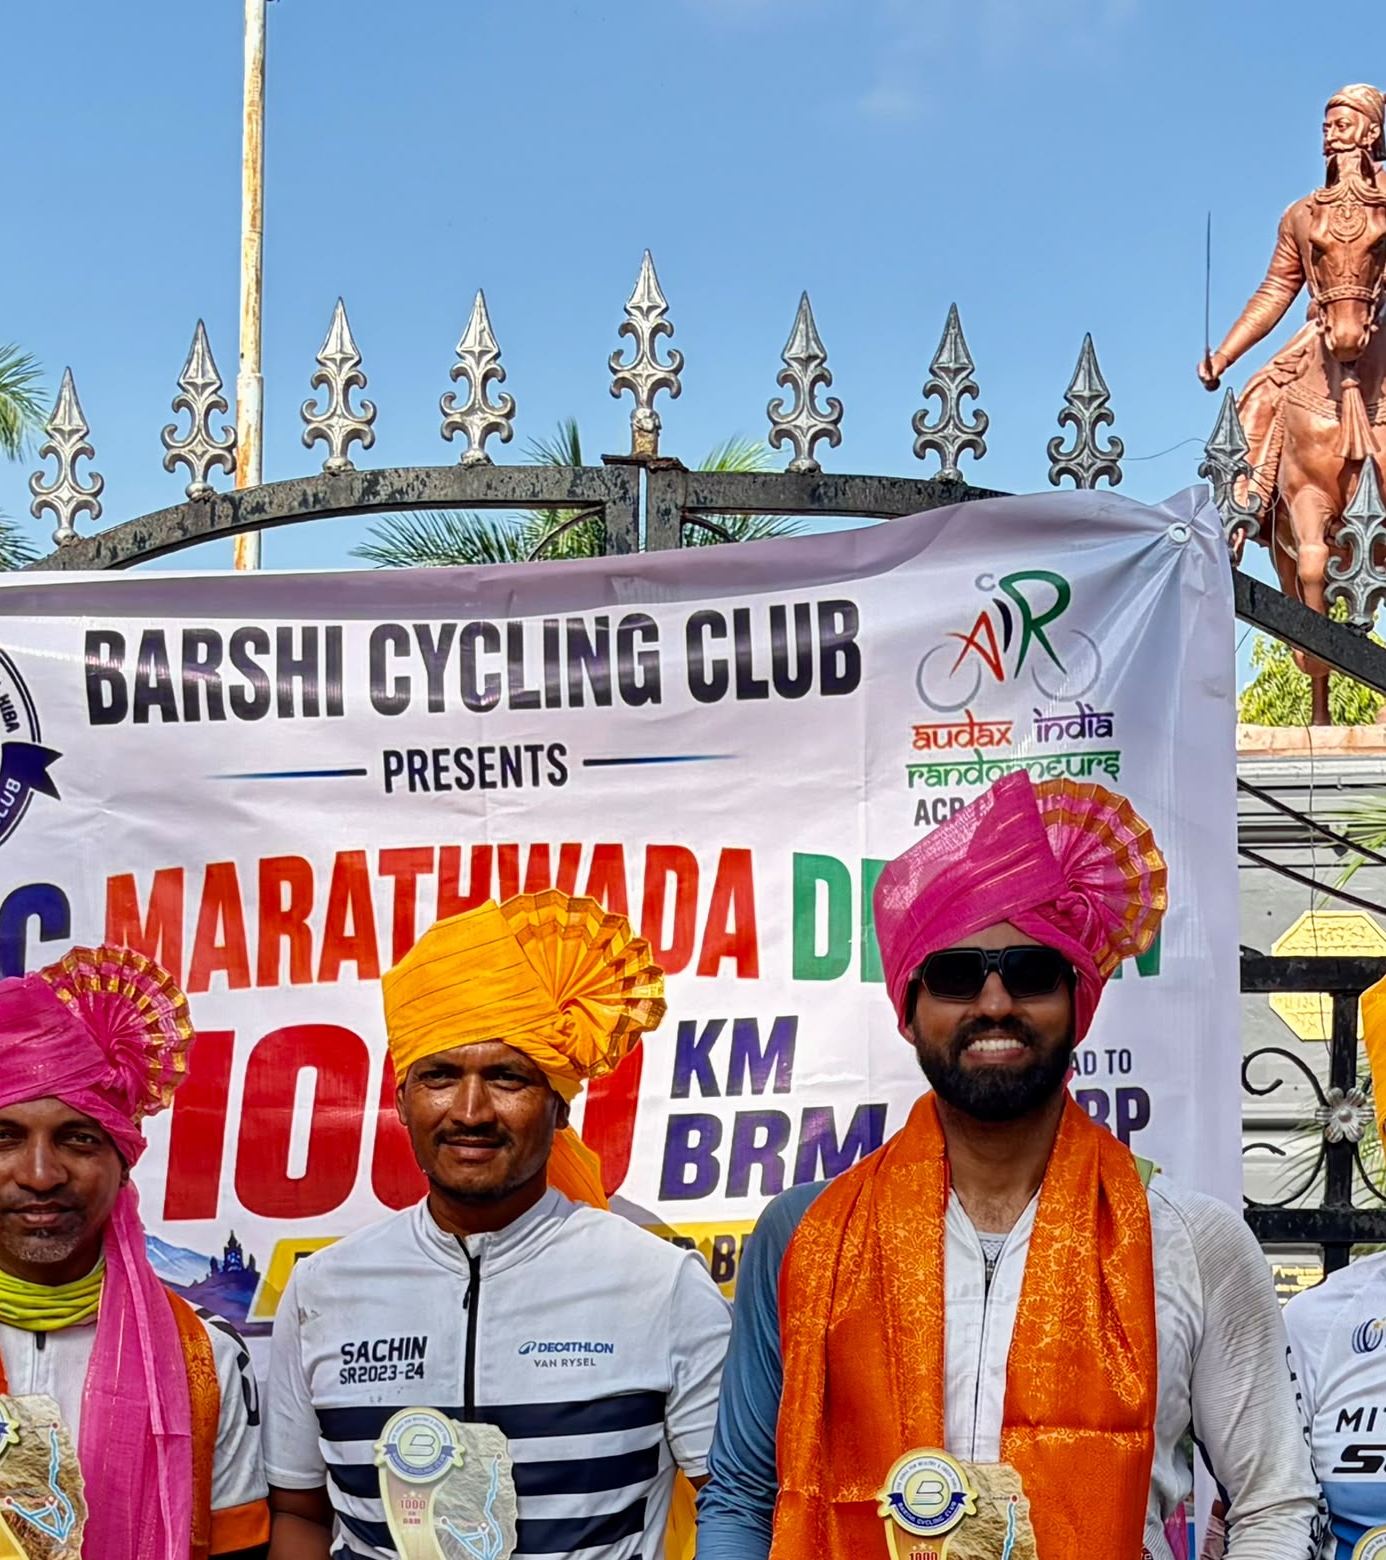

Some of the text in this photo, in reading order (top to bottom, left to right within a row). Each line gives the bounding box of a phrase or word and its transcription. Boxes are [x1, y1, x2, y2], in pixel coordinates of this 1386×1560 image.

[84, 600, 861, 726] BARSHI CYCLING CLUB
[911, 701, 1115, 750] audax india
[383, 742, 568, 793] PRESENTS
[671, 1015, 799, 1099] KM
[1105, 1049, 1132, 1075] TO
[658, 1103, 888, 1201] BRM
[340, 1335, 428, 1366] SACHIN
[534, 1357, 597, 1368] VAN RYSEL
[537, 1341, 614, 1355] DECATHLON
[339, 1362, 424, 1385] SR2023-24
[400, 1499, 426, 1510] 1000
